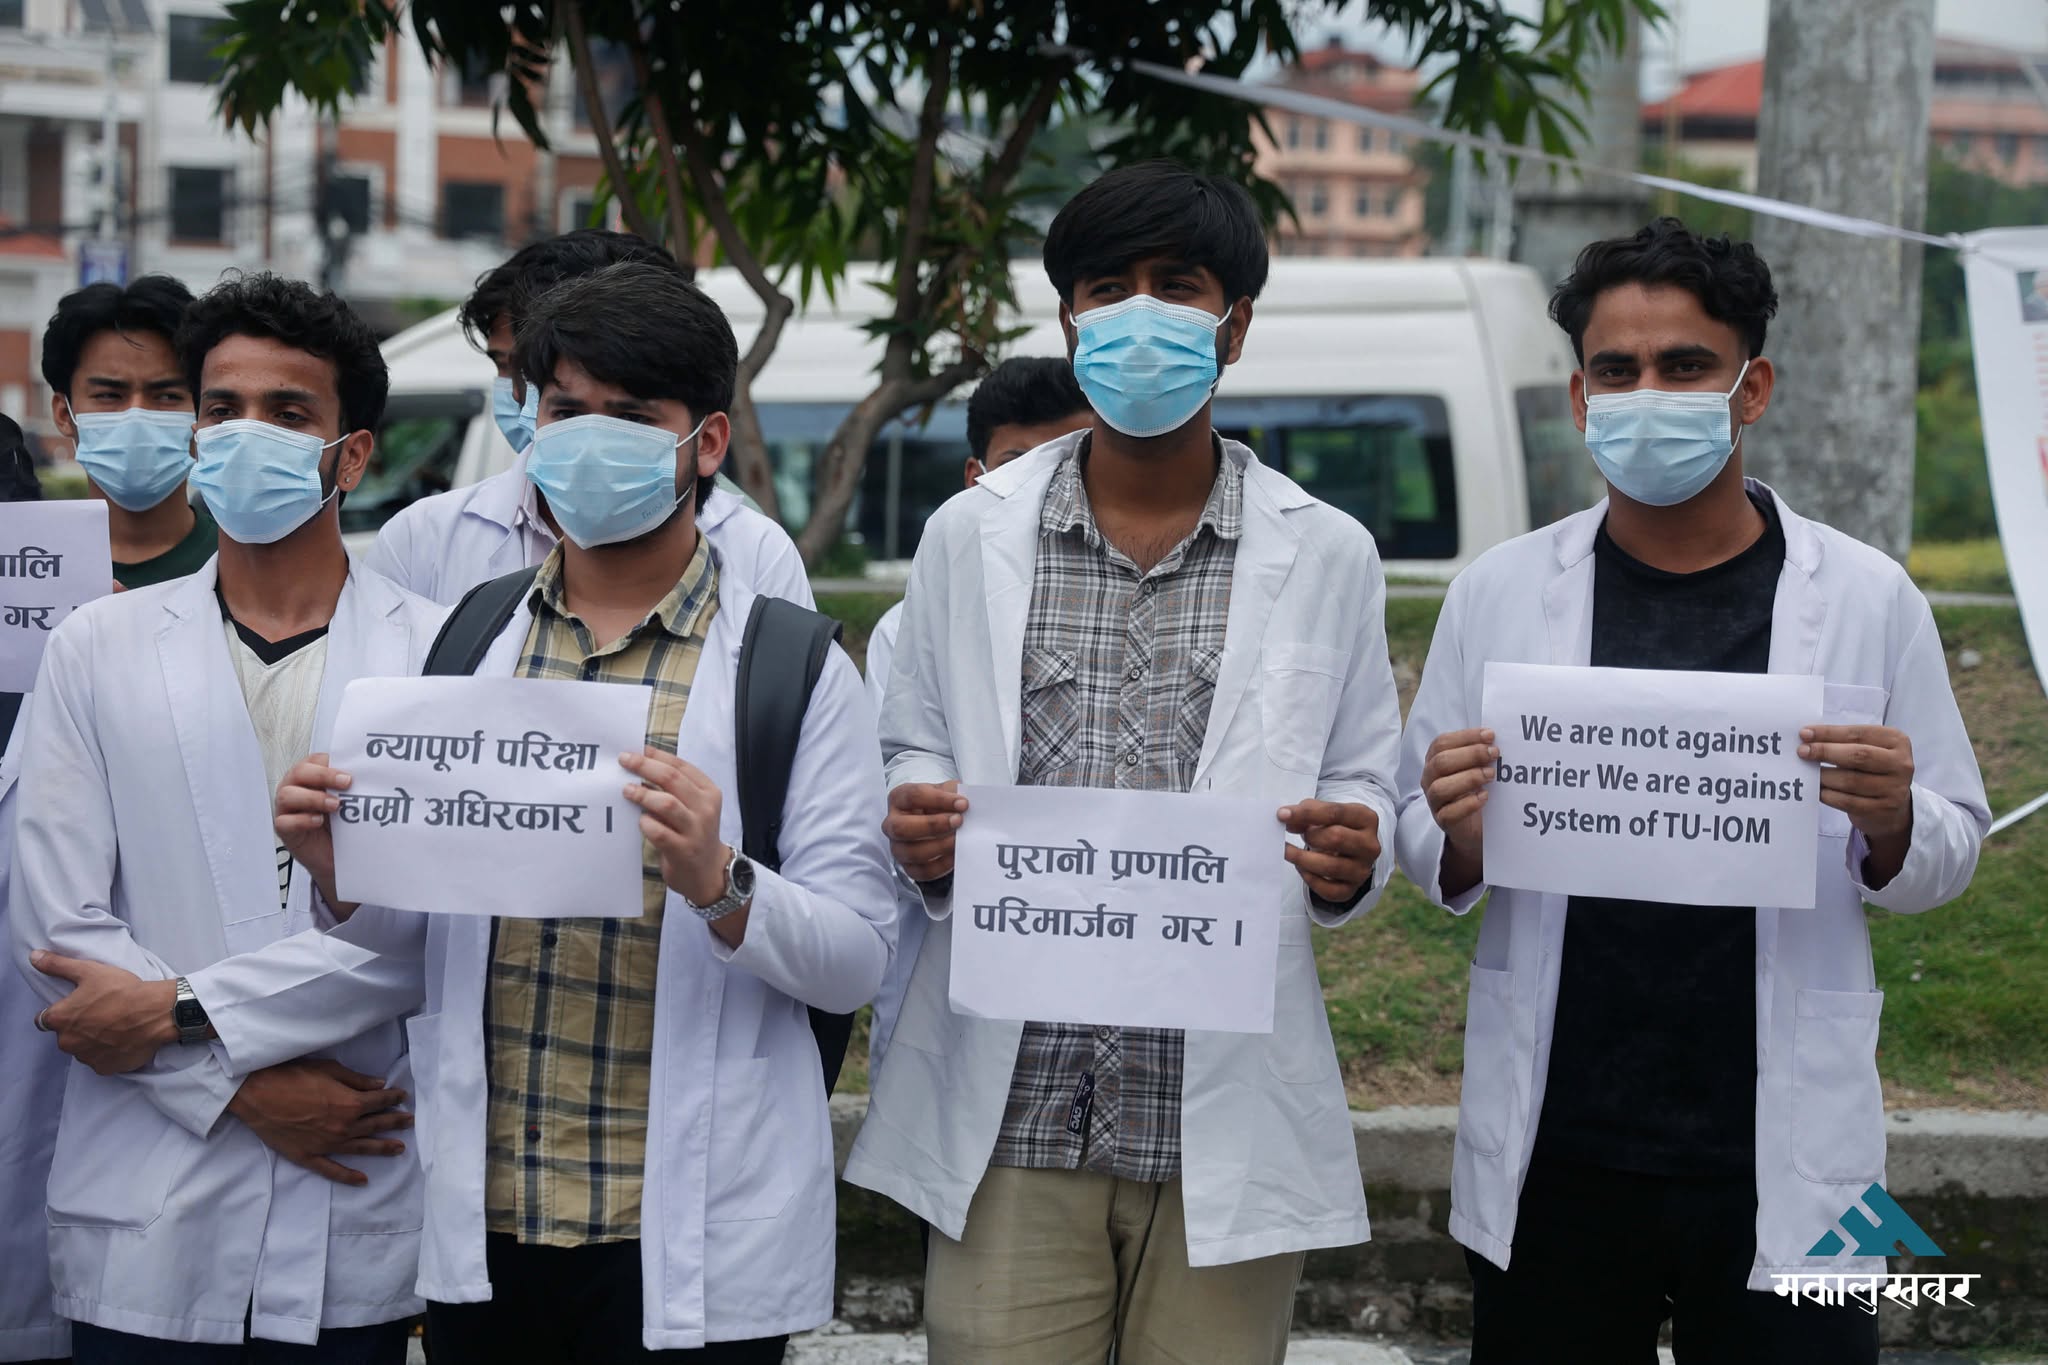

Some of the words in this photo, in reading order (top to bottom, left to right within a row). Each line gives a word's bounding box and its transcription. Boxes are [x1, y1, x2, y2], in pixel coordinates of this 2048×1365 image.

[4, 605, 55, 630] गर
[365, 730, 485, 773] न्यापूर्ण
[496, 731, 600, 774] परिक्षा
[1520, 714, 1563, 743] We
[1569, 724, 1614, 746] are
[1621, 724, 1669, 750] not
[1675, 726, 1782, 759] against
[1496, 756, 1591, 788] barrier
[1596, 763, 1639, 791] We
[1645, 773, 1691, 795] are
[1697, 772, 1804, 804] against
[338, 787, 414, 827] हाम्रो
[423, 789, 588, 834] अधिरकार
[1522, 802, 1621, 836] System
[1628, 809, 1659, 837] of
[1663, 812, 1770, 845] TU-IOM
[996, 839, 1099, 880] पुरानो
[1110, 844, 1229, 884] प्रणालि
[972, 896, 1138, 940] परिमार्जन
[1161, 914, 1217, 946] गर
